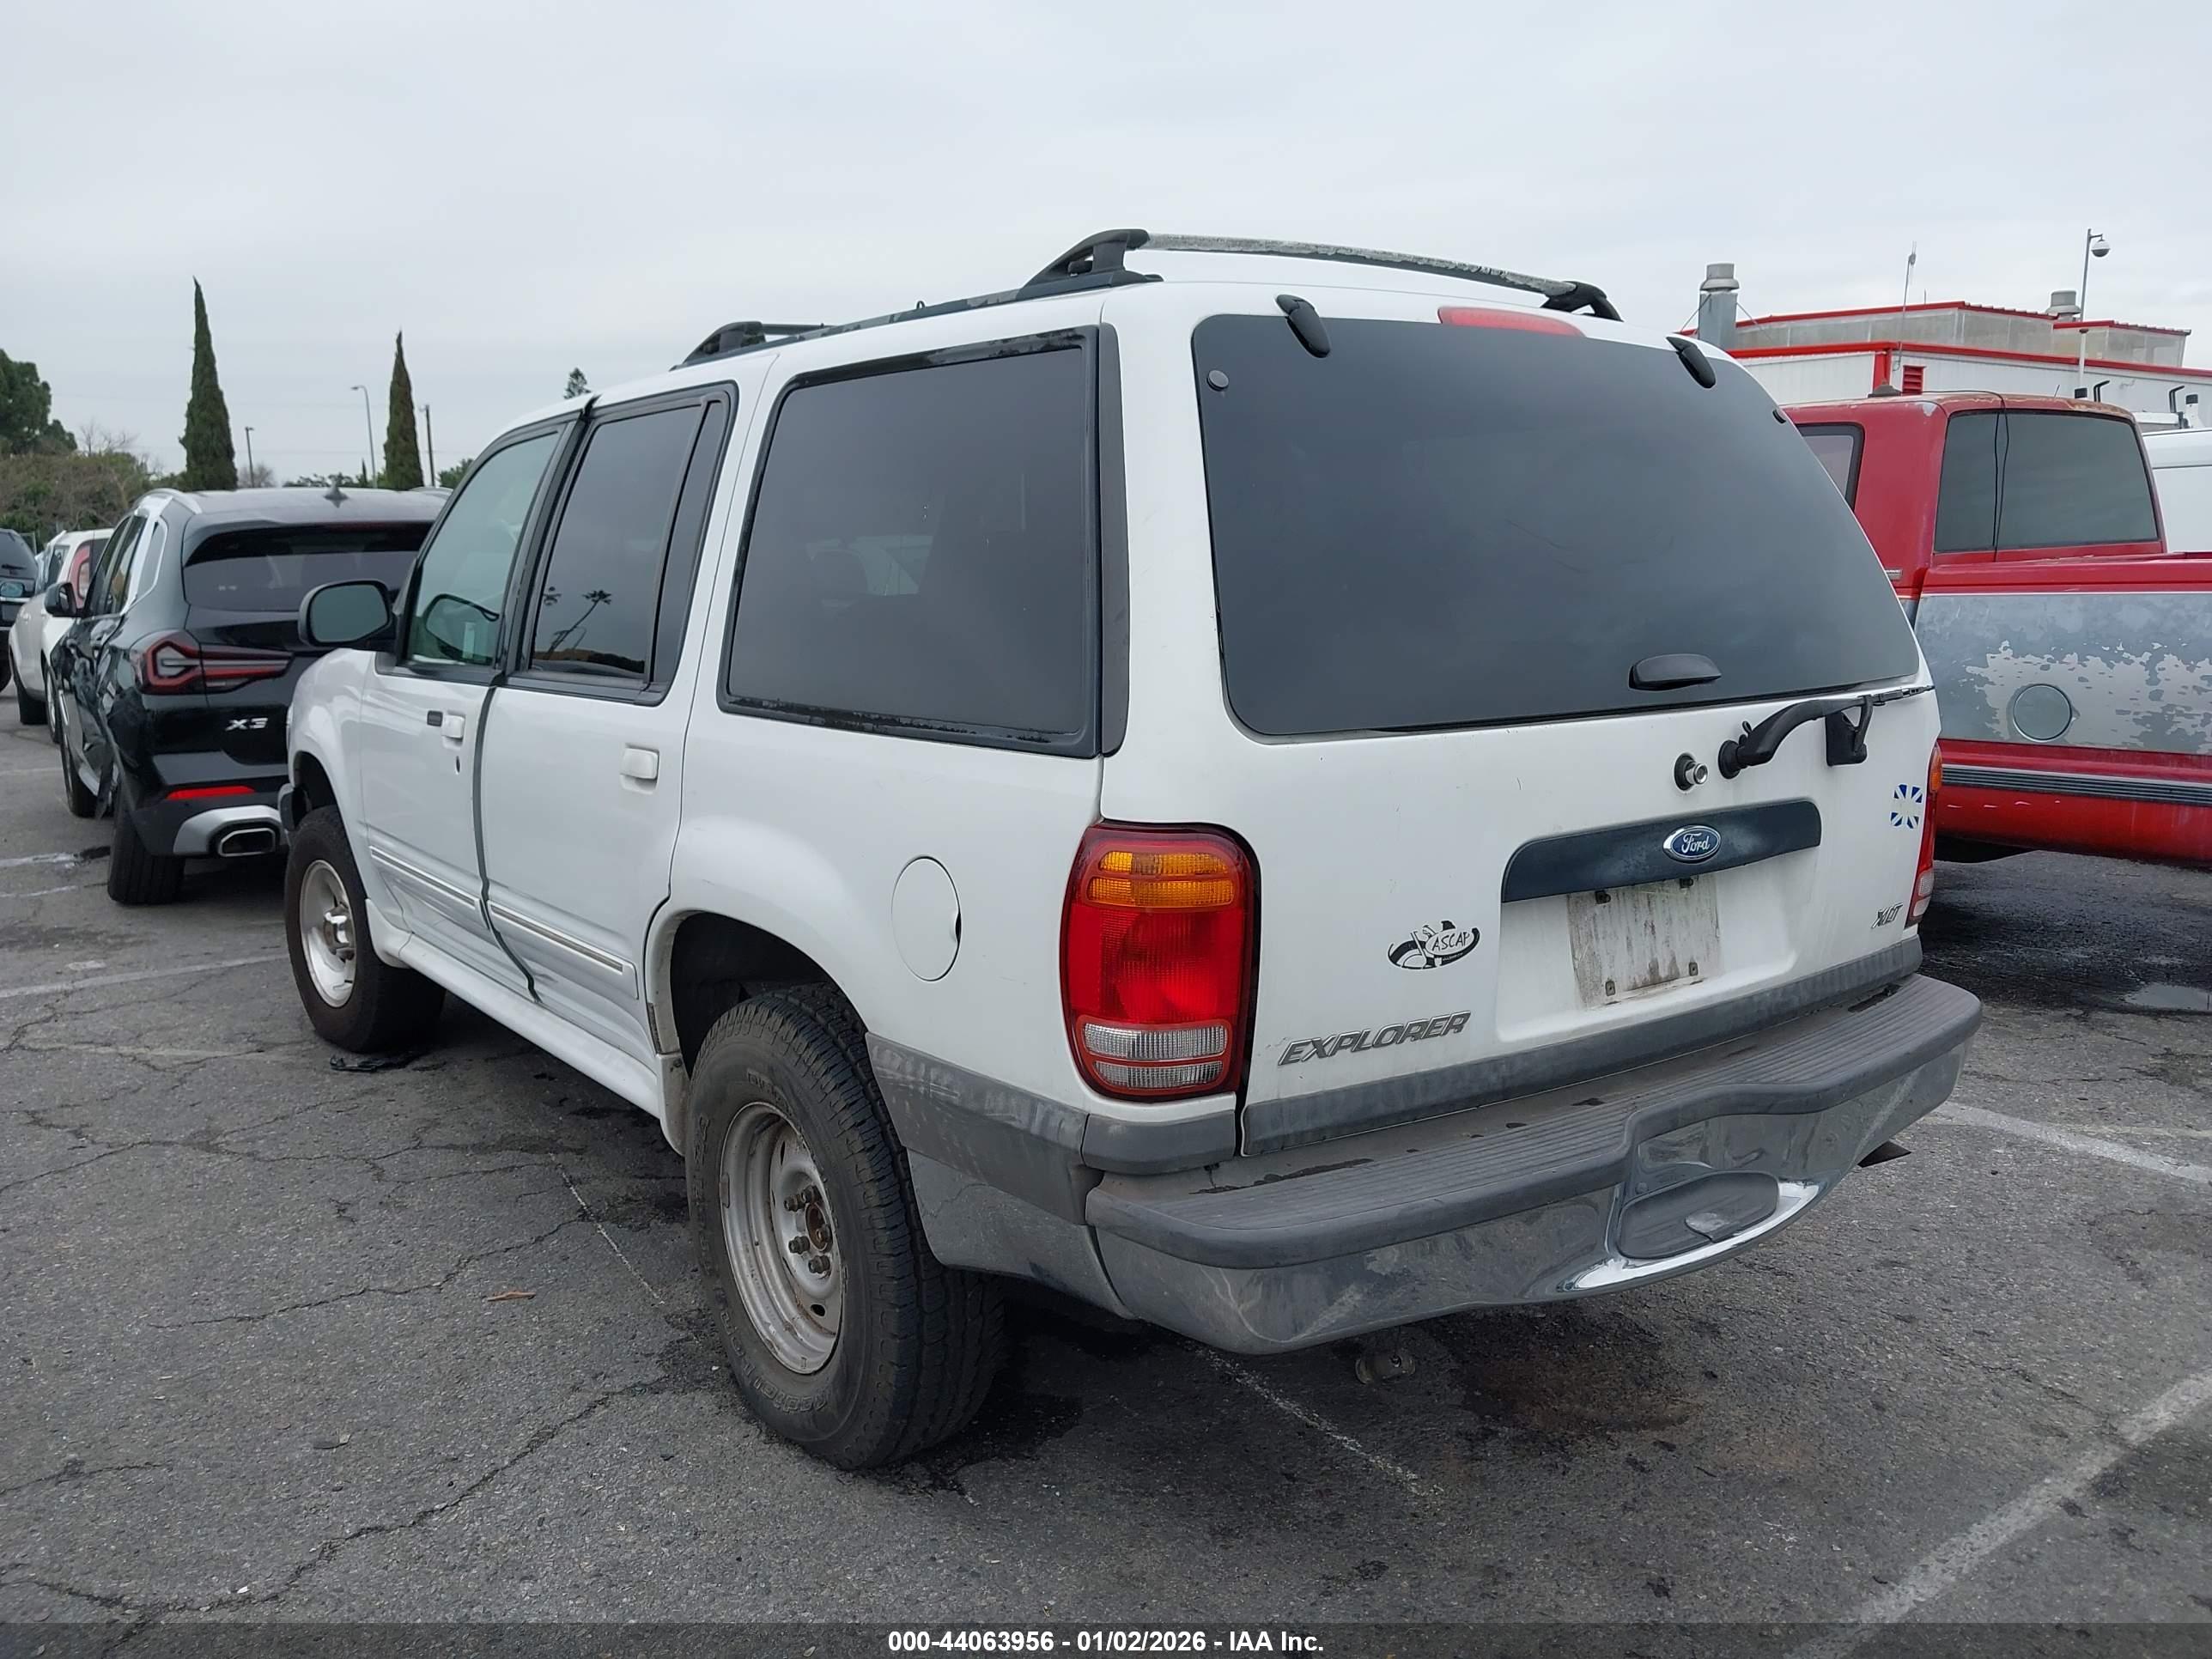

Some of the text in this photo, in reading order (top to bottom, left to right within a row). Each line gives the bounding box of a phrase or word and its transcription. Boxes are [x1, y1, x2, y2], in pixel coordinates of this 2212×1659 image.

[225, 718, 268, 731] X3
[1681, 832, 1711, 854] Ford
[1431, 932, 1470, 951] ASCAP
[1278, 1011, 1471, 1066] EXPLORER
